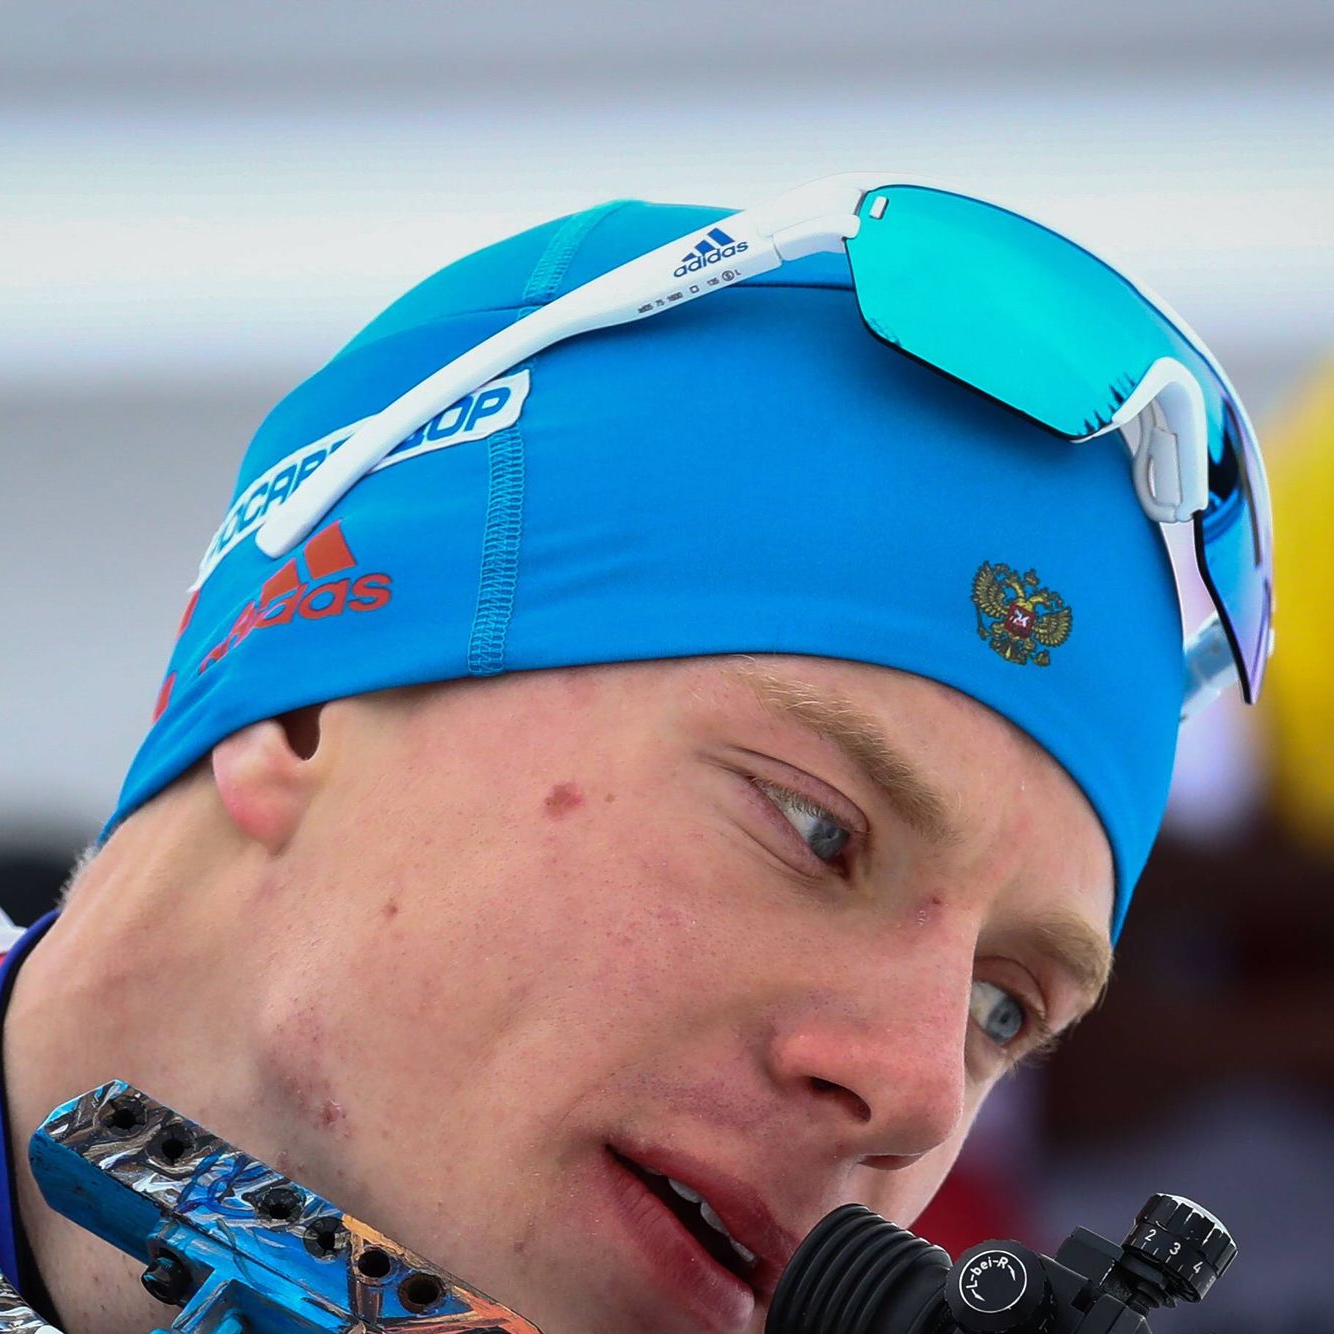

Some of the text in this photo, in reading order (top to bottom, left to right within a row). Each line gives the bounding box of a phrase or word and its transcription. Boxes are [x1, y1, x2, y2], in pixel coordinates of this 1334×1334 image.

[673, 241, 749, 278] adidas
[1144, 1229, 1204, 1275] 2 3 4
